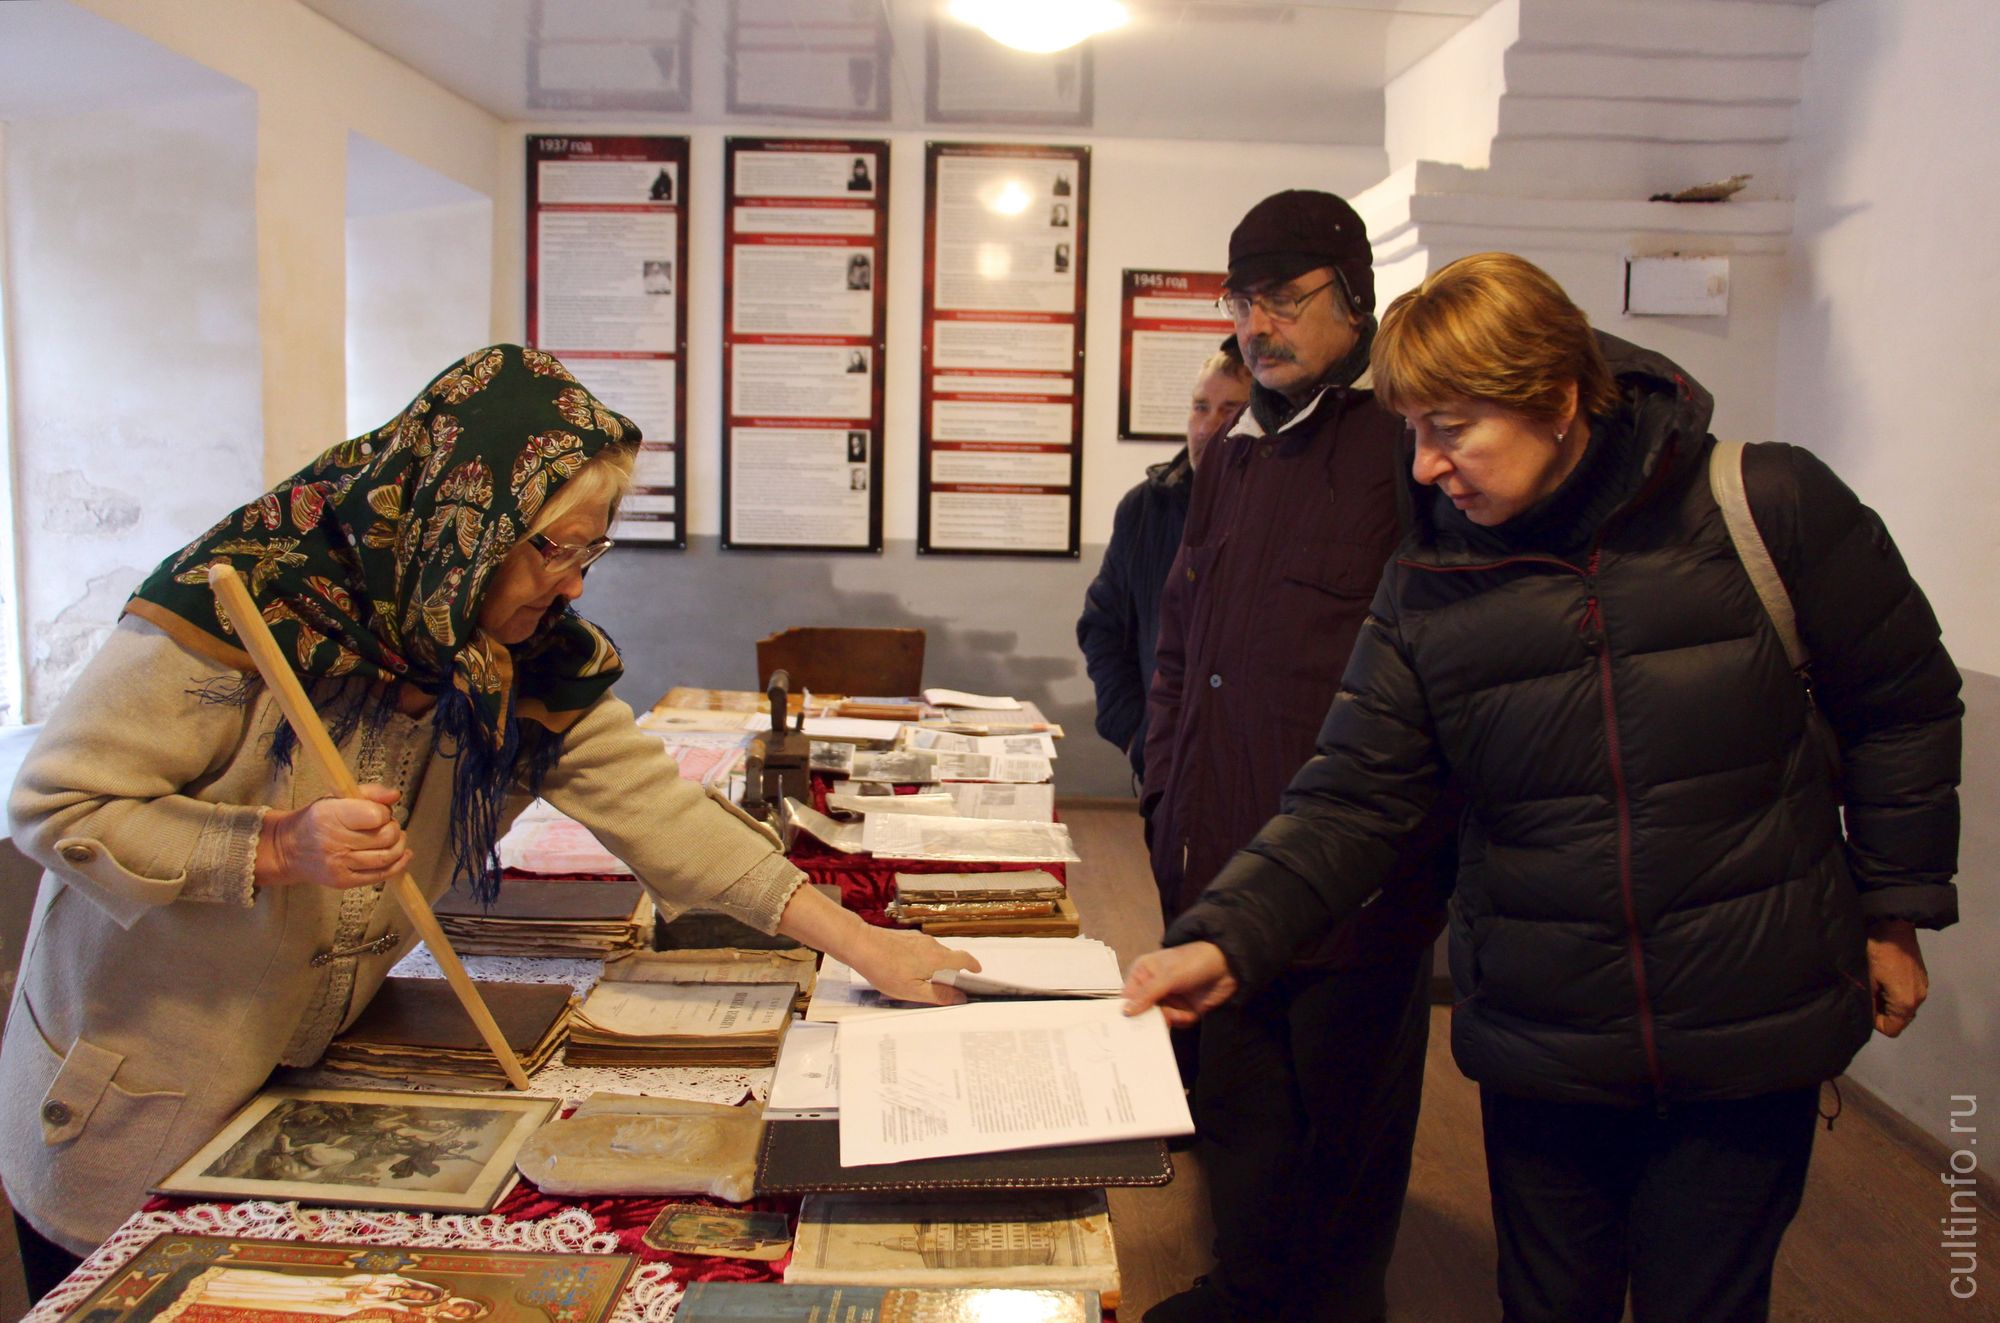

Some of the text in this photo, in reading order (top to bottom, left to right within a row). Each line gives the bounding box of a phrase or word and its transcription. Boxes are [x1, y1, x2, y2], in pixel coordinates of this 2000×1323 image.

[539, 139, 593, 154] 1937 год
[1133, 273, 1188, 289] 1945 год
